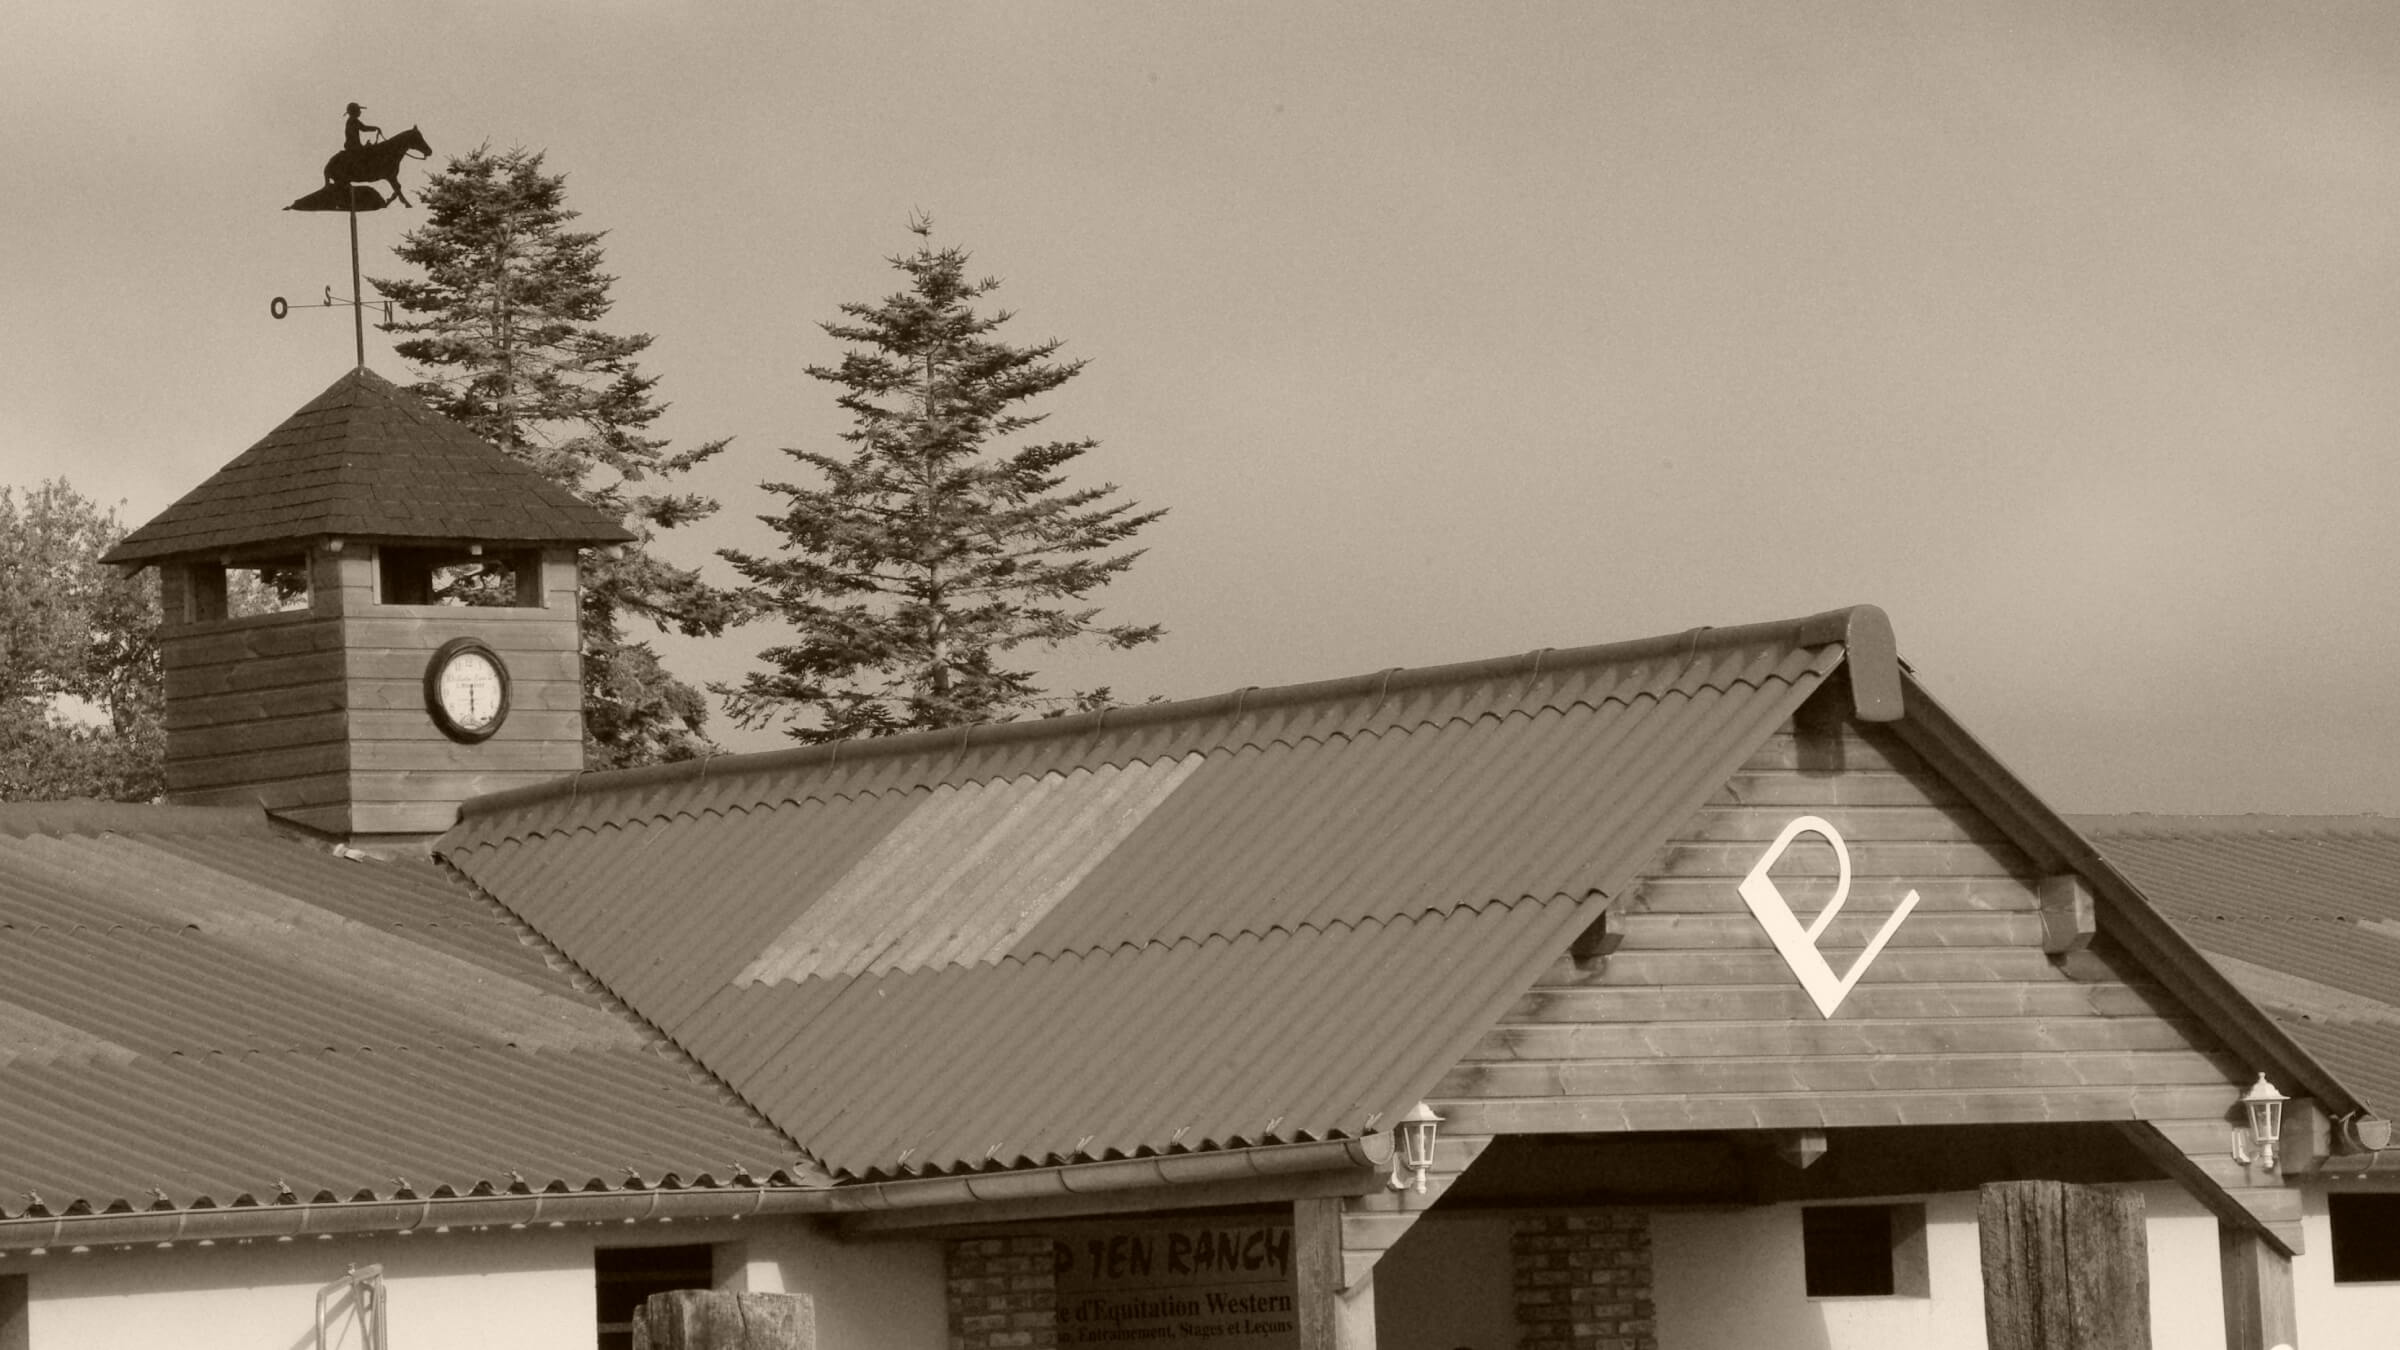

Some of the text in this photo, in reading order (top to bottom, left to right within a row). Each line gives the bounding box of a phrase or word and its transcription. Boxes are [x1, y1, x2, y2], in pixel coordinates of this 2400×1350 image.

[324, 285, 332, 306] S
[271, 297, 288, 319] O
[1088, 1235, 1154, 1280] TEN
[1168, 1228, 1290, 1277] RANCH
[1076, 1296, 1200, 1327] d'Equitation
[1206, 1292, 1291, 1314] Western
[1180, 1321, 1224, 1337] Stages
[1228, 1319, 1241, 1333] et
[1245, 1318, 1293, 1337] Leçons
